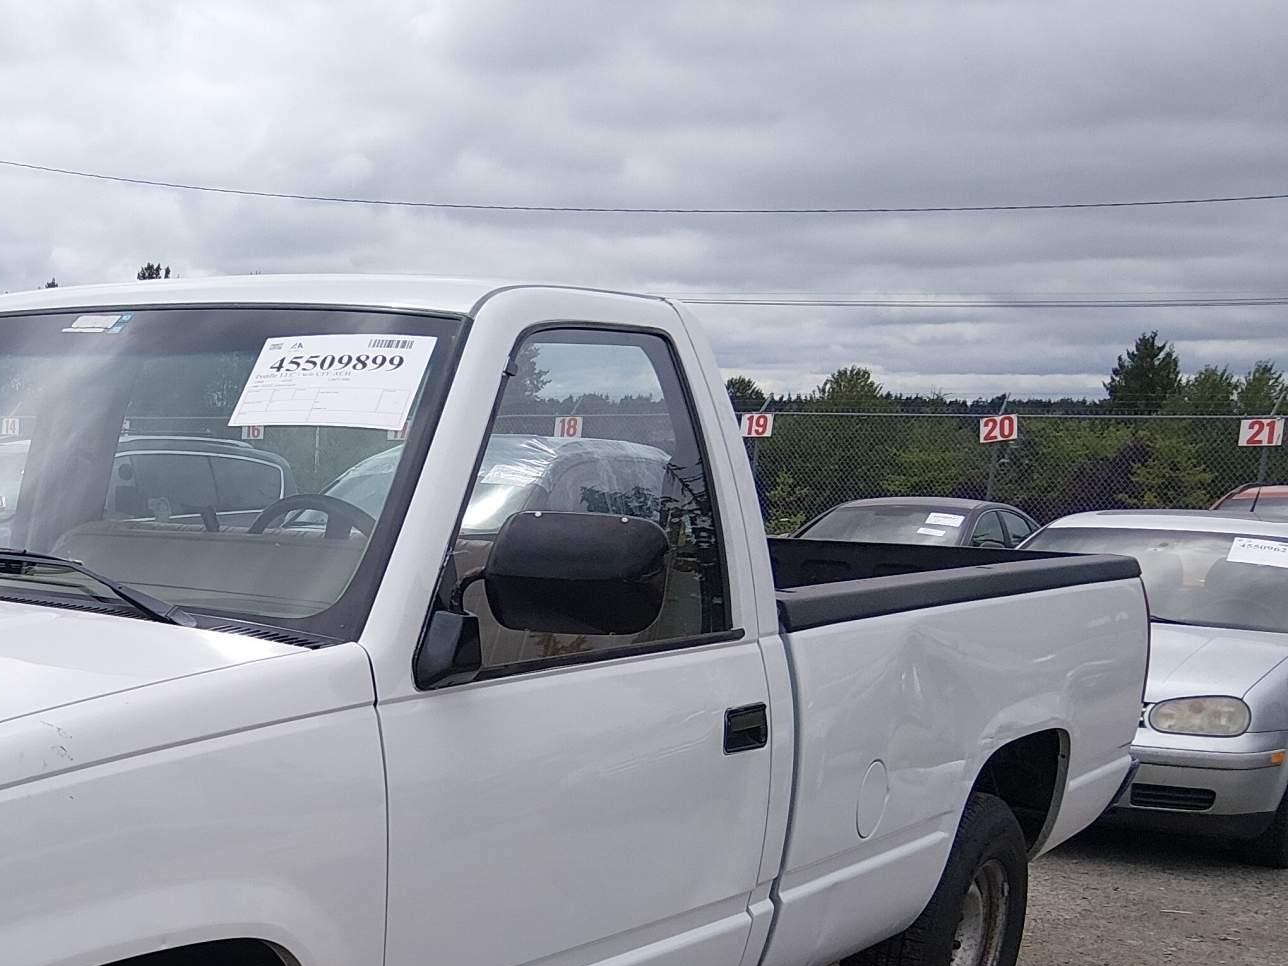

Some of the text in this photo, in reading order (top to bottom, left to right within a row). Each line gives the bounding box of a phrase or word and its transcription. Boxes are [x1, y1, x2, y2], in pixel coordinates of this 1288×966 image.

[269, 354, 405, 373] 45509899
[246, 426, 261, 439] 16
[558, 417, 578, 437] 18
[746, 415, 768, 436] 19
[983, 416, 1014, 441] 20
[1246, 420, 1276, 445] 21
